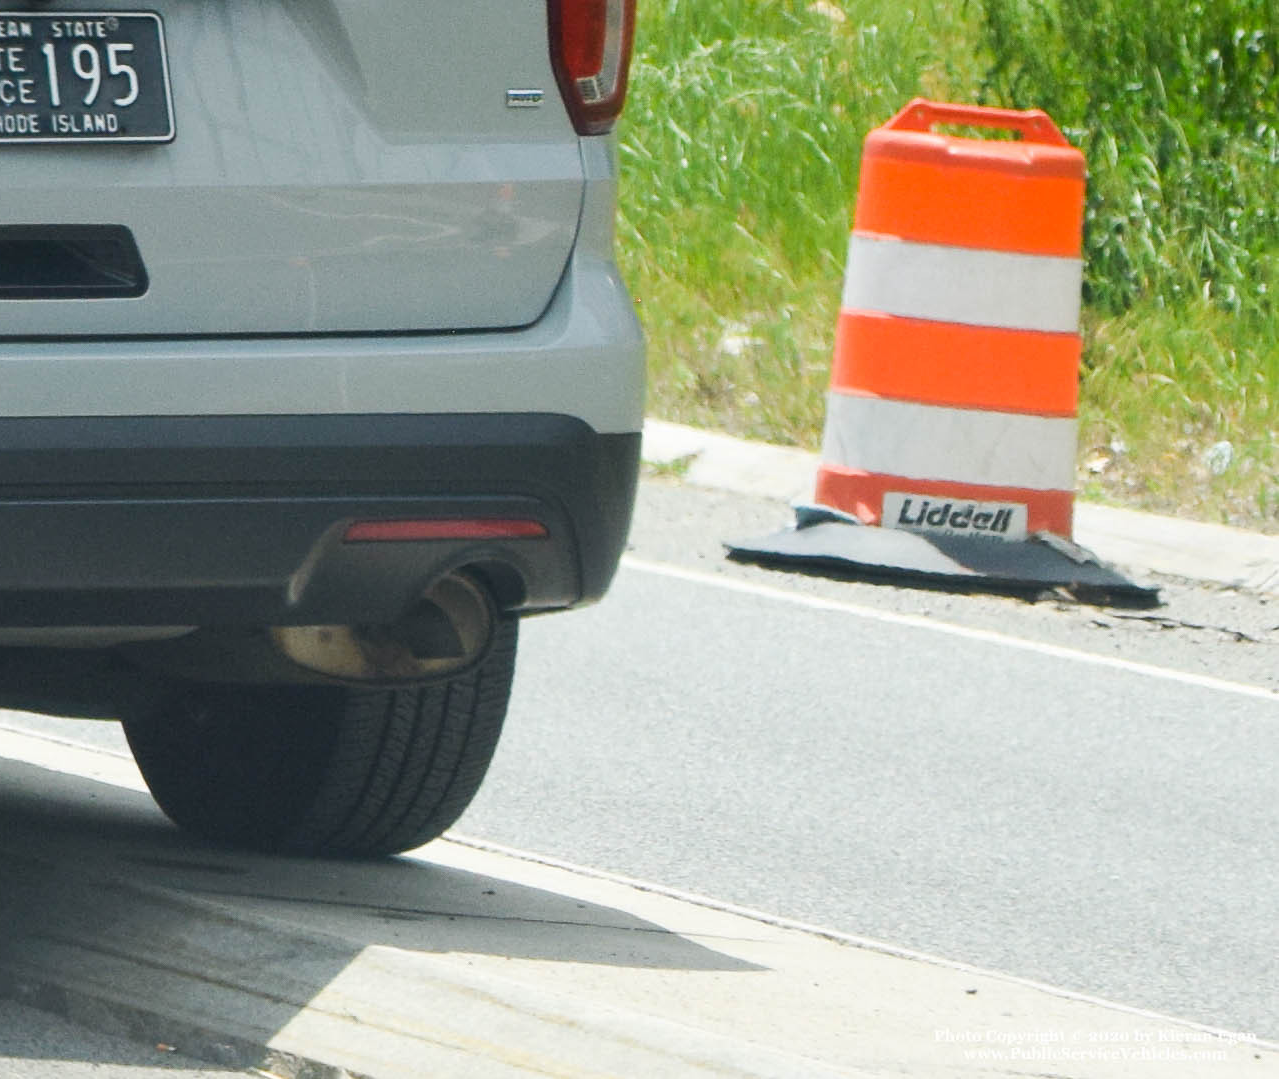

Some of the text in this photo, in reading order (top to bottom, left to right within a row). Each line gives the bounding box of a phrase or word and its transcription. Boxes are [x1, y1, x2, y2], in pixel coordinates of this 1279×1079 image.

[51, 21, 107, 38] STATE
[41, 42, 140, 108] 195
[52, 113, 119, 133] ISLAND
[898, 498, 1014, 533] Liddell
